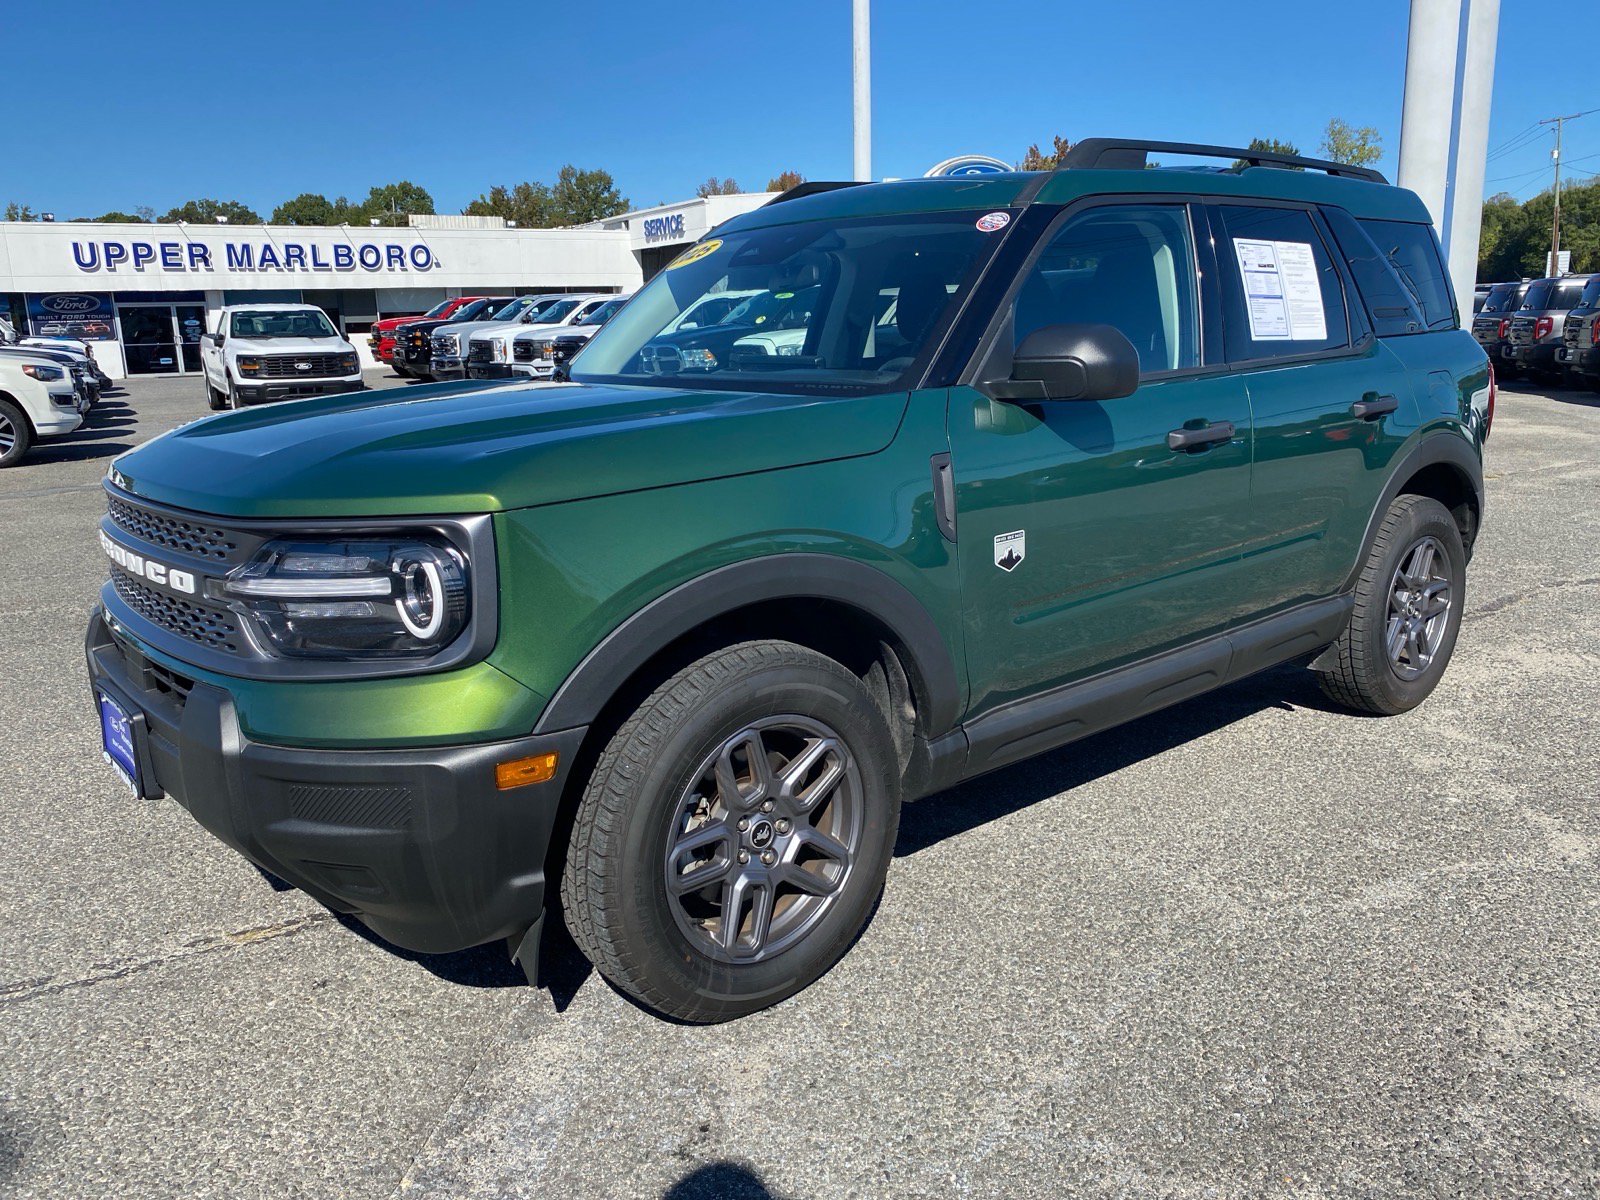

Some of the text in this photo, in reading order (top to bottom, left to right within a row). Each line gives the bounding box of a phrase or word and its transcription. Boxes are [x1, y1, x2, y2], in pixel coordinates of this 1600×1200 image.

[644, 214, 683, 237] SERVICE
[72, 241, 433, 271] UPPER MARLBORO
[53, 296, 90, 310] Ford
